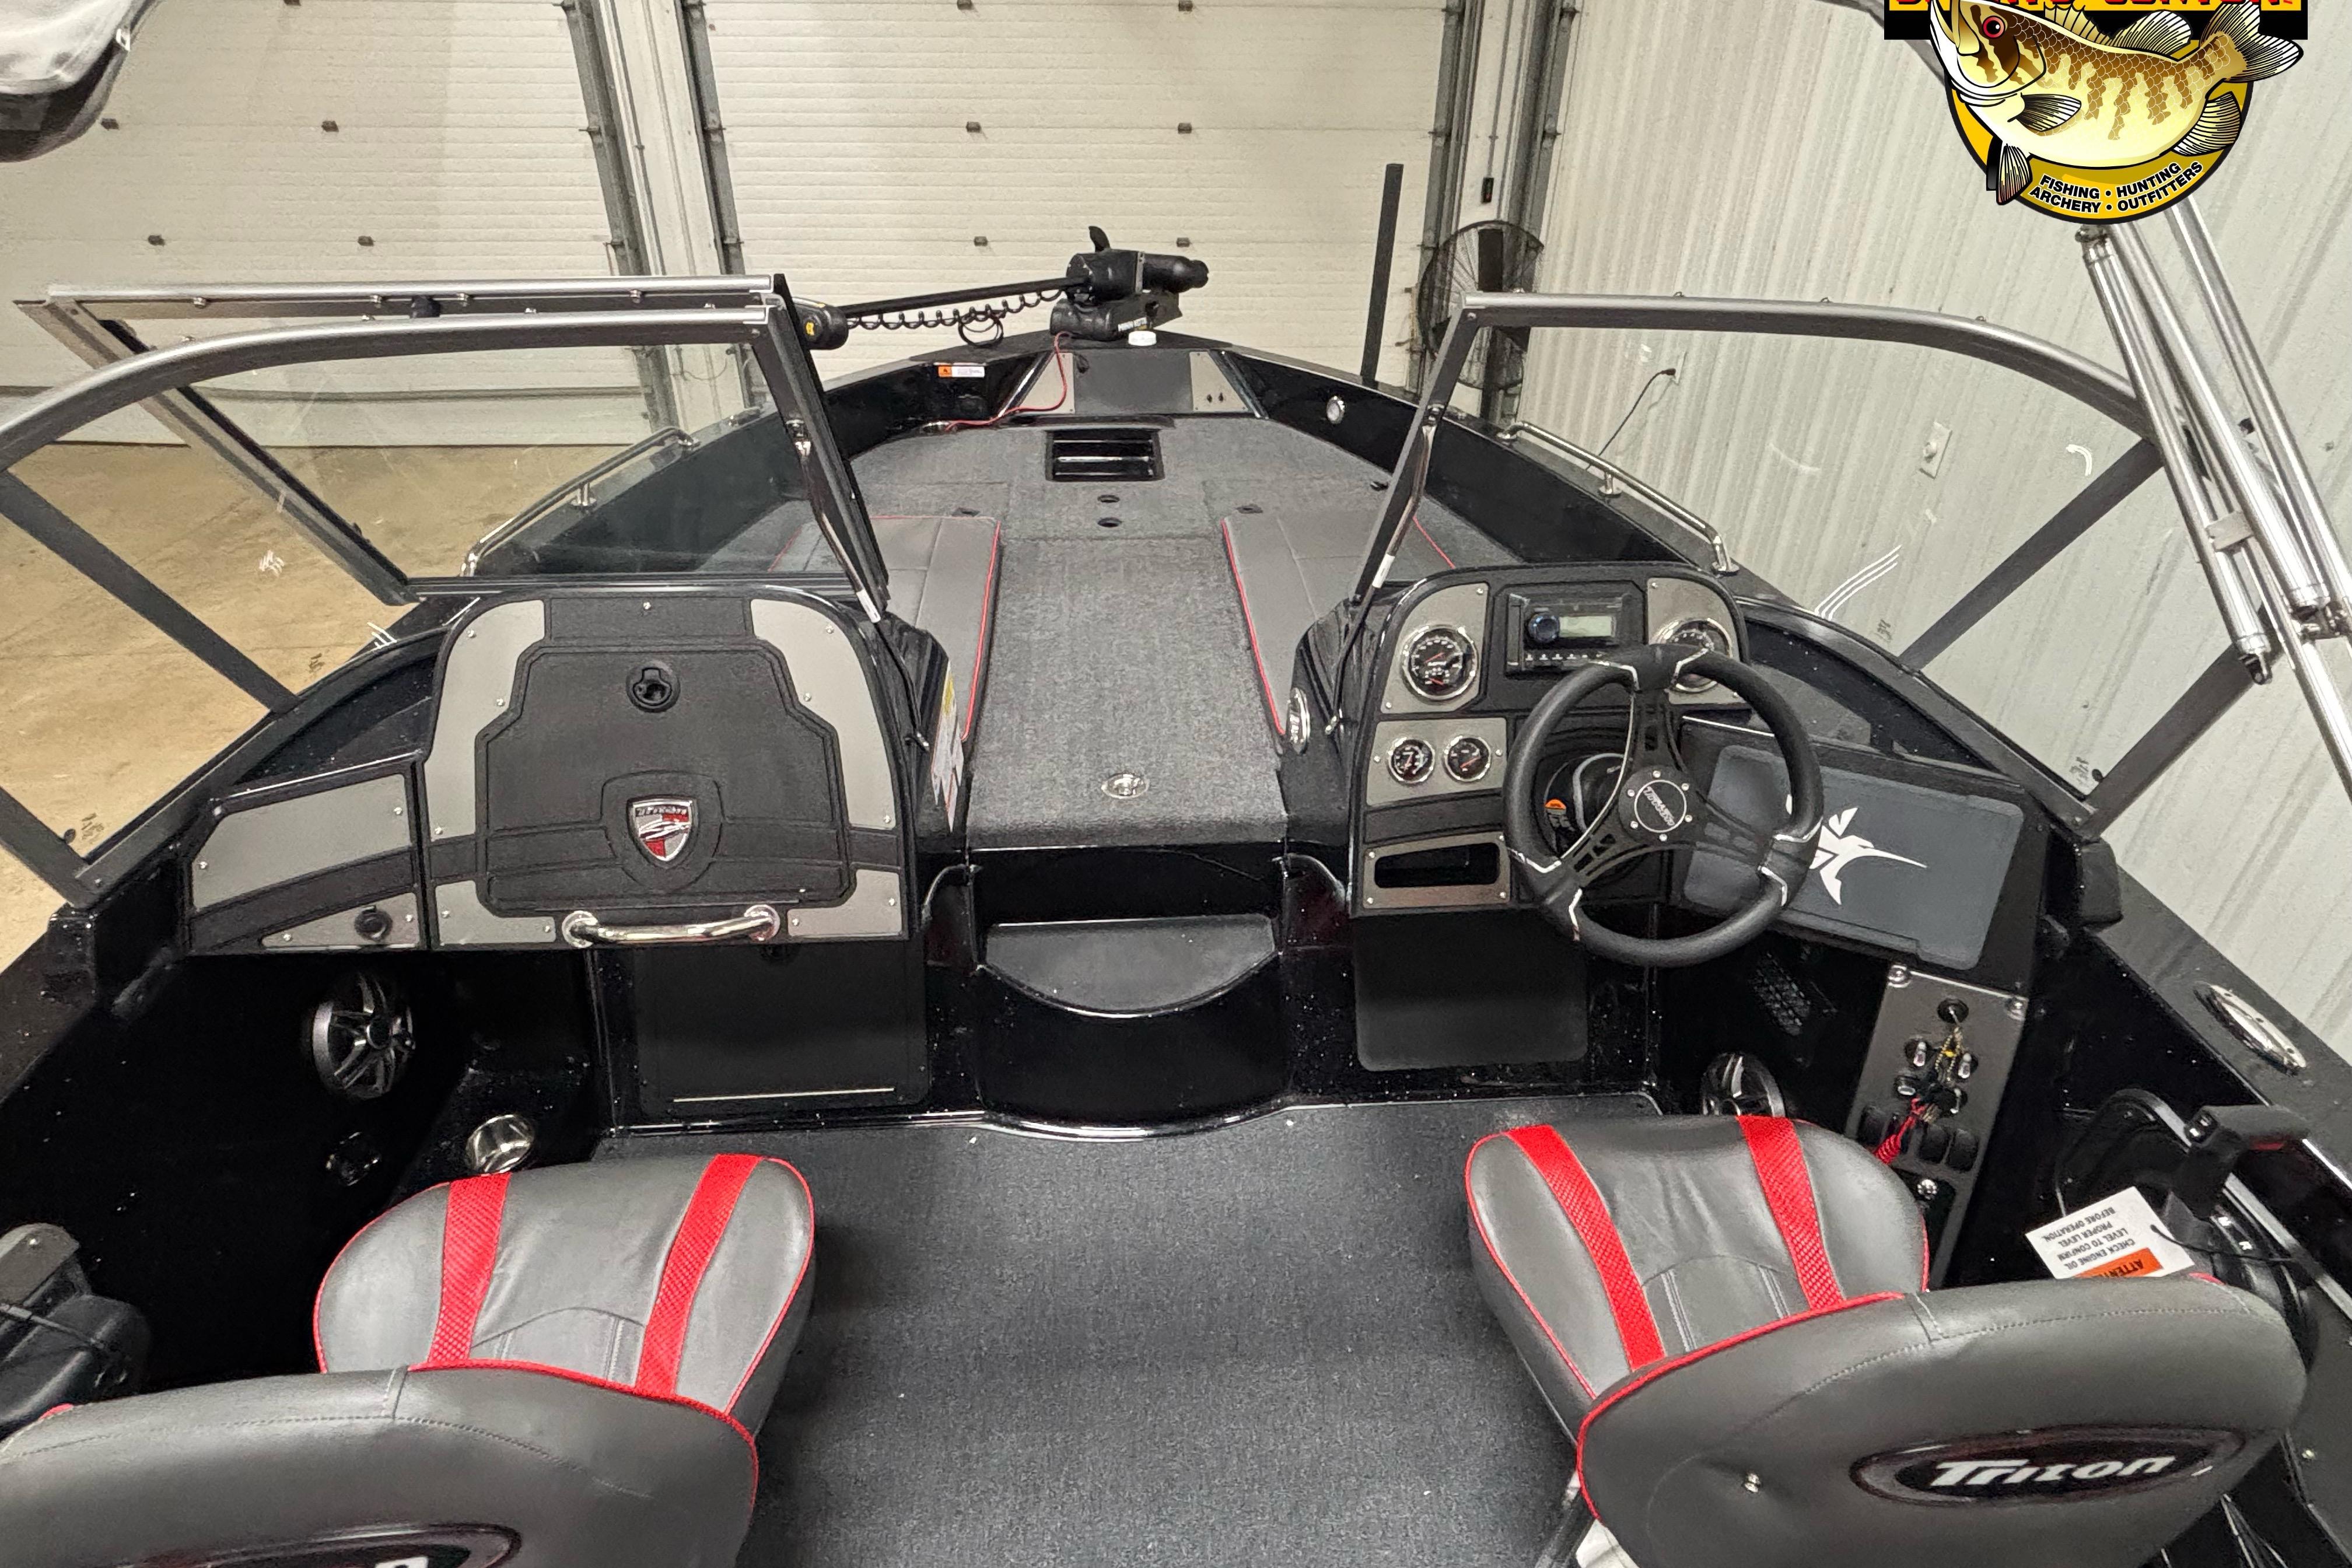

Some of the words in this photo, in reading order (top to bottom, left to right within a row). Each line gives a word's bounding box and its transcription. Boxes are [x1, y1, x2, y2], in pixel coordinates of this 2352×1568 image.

[2084, 1207, 2116, 1224] BEFORE
[2081, 1221, 2113, 1238] PROPER
[2102, 1227, 2129, 1242] LEVEL
[2058, 1234, 2082, 1247] LEVEL
[2091, 1238, 2104, 1247] TO
[2106, 1238, 2136, 1253] CHECK
[2057, 1243, 2091, 1261] CONFIRM
[2078, 1249, 2108, 1265] ENGINE
[2064, 1261, 2078, 1270] OIL
